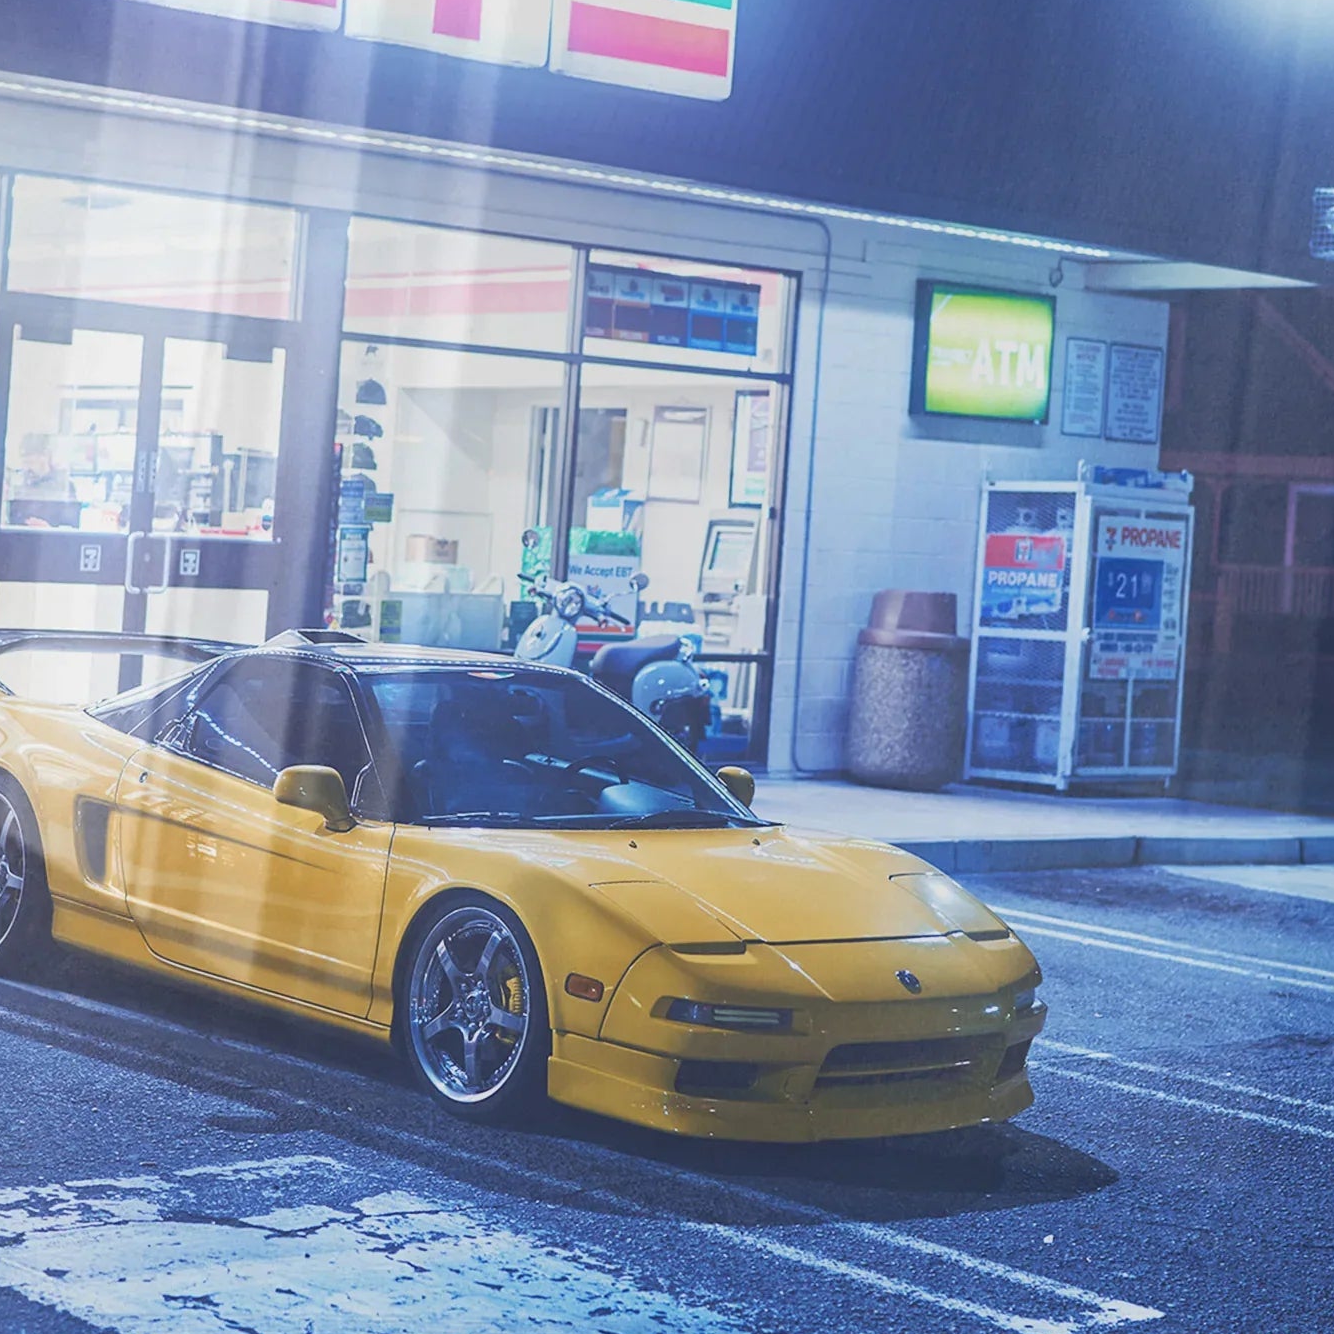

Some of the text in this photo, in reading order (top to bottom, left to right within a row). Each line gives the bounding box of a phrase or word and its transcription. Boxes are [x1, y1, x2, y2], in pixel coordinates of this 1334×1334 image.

[971, 337, 1046, 389] ATM
[1120, 525, 1183, 550] PROPANE
[615, 566, 634, 579] EBT
[986, 570, 1059, 588] PROPANE
